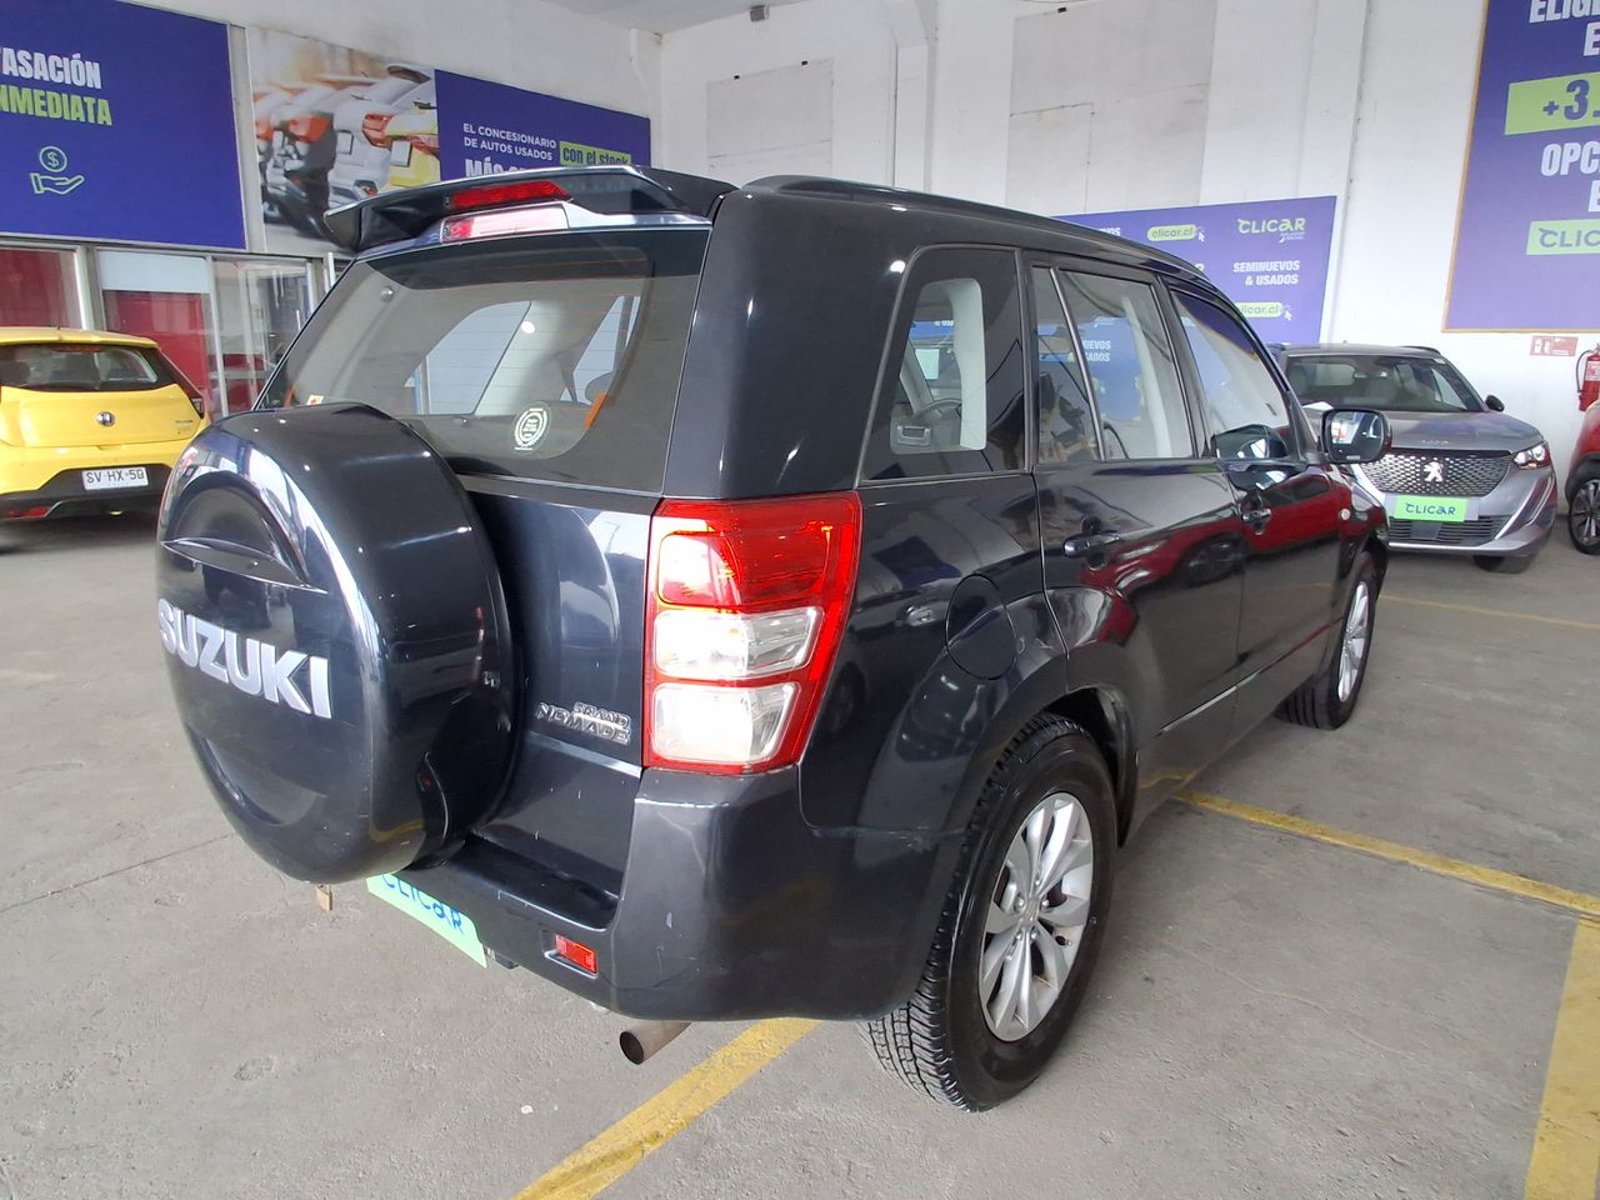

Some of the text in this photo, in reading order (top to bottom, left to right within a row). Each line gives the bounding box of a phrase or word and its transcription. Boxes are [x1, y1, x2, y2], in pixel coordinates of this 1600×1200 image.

[0, 46, 102, 90] ASACIÓN
[0, 84, 112, 126] NMEDIATA
[463, 123, 557, 149] EL CONCESIONARIO
[464, 137, 553, 161] DE AUTOS USADOS
[563, 147, 583, 164] con
[586, 151, 596, 165] el
[1151, 226, 1193, 239] clicar.cl
[1233, 260, 1300, 272] SEMINUEVOS
[1245, 274, 1299, 286] & USADOS
[157, 598, 332, 720] SUZUKI
